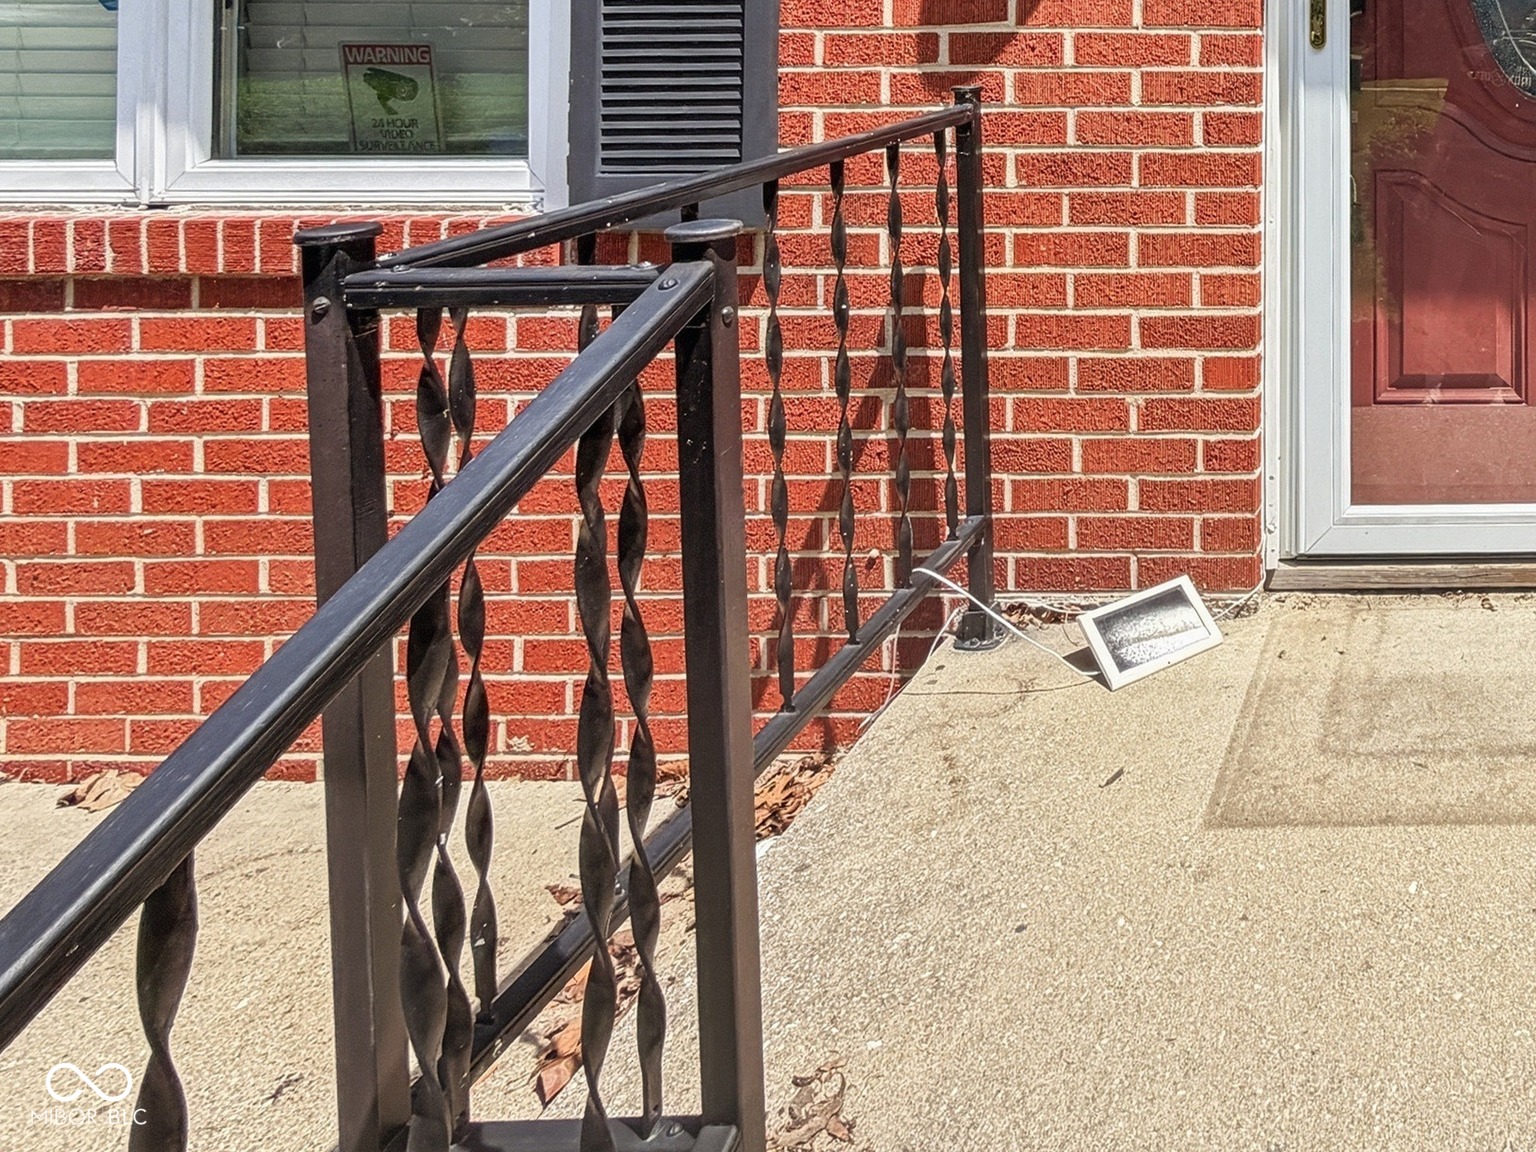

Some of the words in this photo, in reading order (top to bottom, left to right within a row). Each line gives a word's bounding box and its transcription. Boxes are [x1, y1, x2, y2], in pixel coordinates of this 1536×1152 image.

[345, 46, 430, 64] WARNING
[386, 118, 419, 129] HOUR
[380, 129, 414, 140] VIDEO
